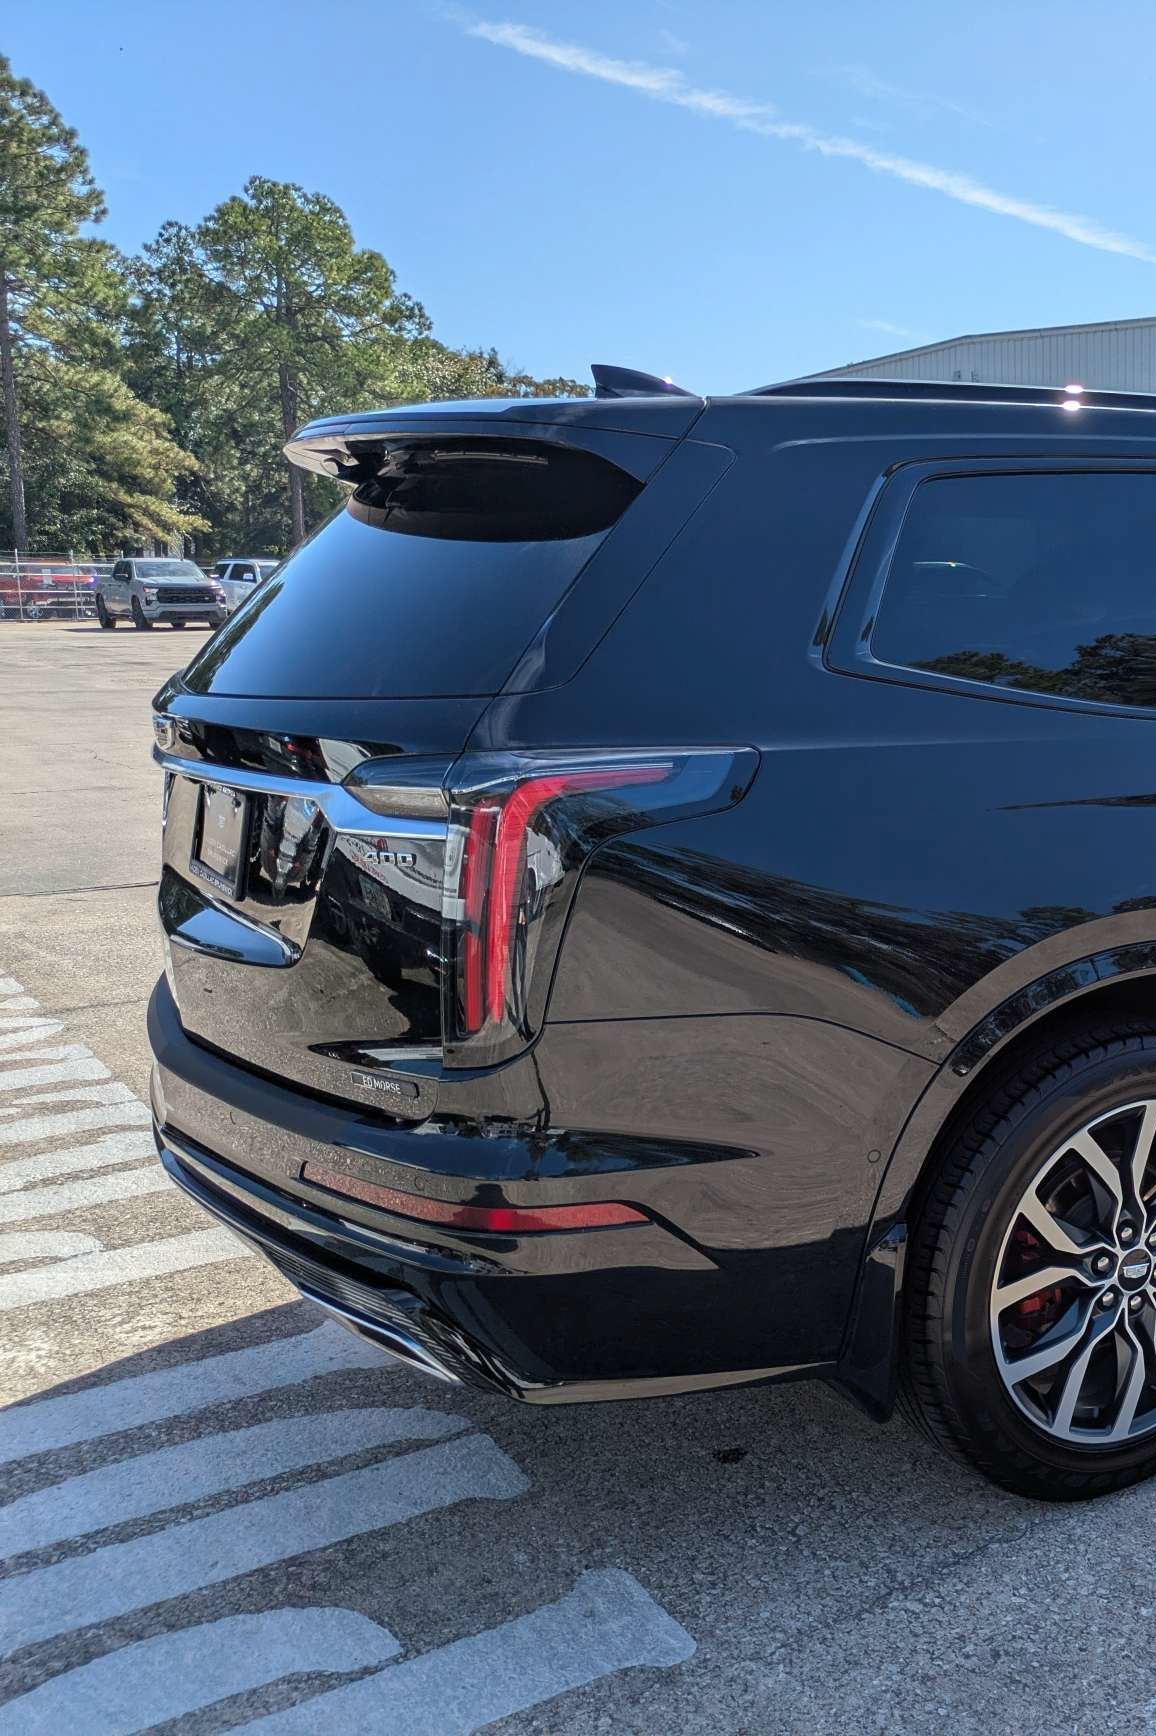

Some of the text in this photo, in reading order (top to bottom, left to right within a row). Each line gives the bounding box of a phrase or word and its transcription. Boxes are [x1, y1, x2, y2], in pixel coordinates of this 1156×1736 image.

[364, 852, 414, 867] 400
[363, 1075, 401, 1094] ED MORSE
